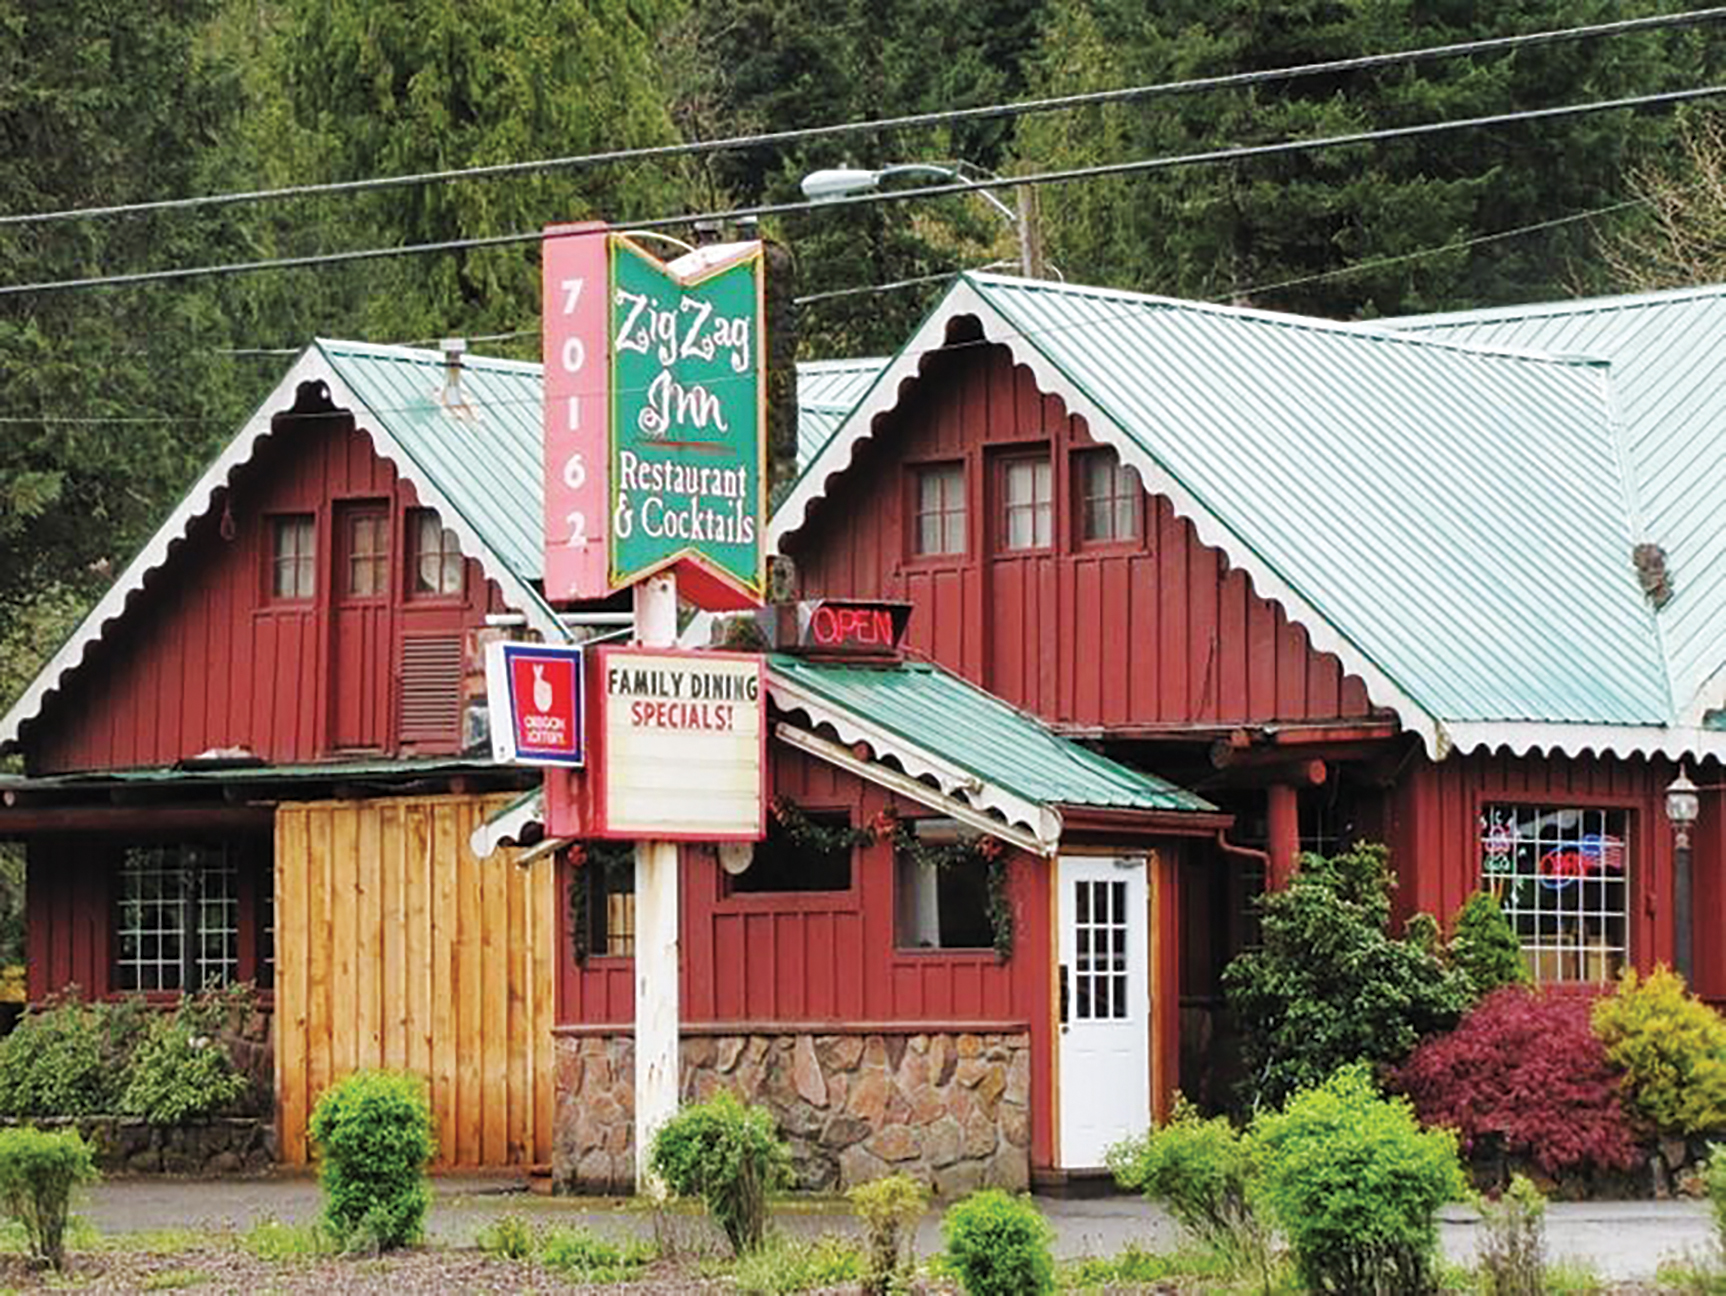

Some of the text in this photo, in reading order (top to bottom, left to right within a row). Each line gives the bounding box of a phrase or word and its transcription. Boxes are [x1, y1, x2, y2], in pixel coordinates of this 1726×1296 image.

[637, 369, 729, 434] Inn
[620, 451, 747, 498] Restaurant
[614, 491, 755, 544] & Cocktails
[813, 606, 893, 646] OPEN
[607, 669, 758, 701] FAMILY DINING
[631, 701, 734, 731] SPECIALS!
